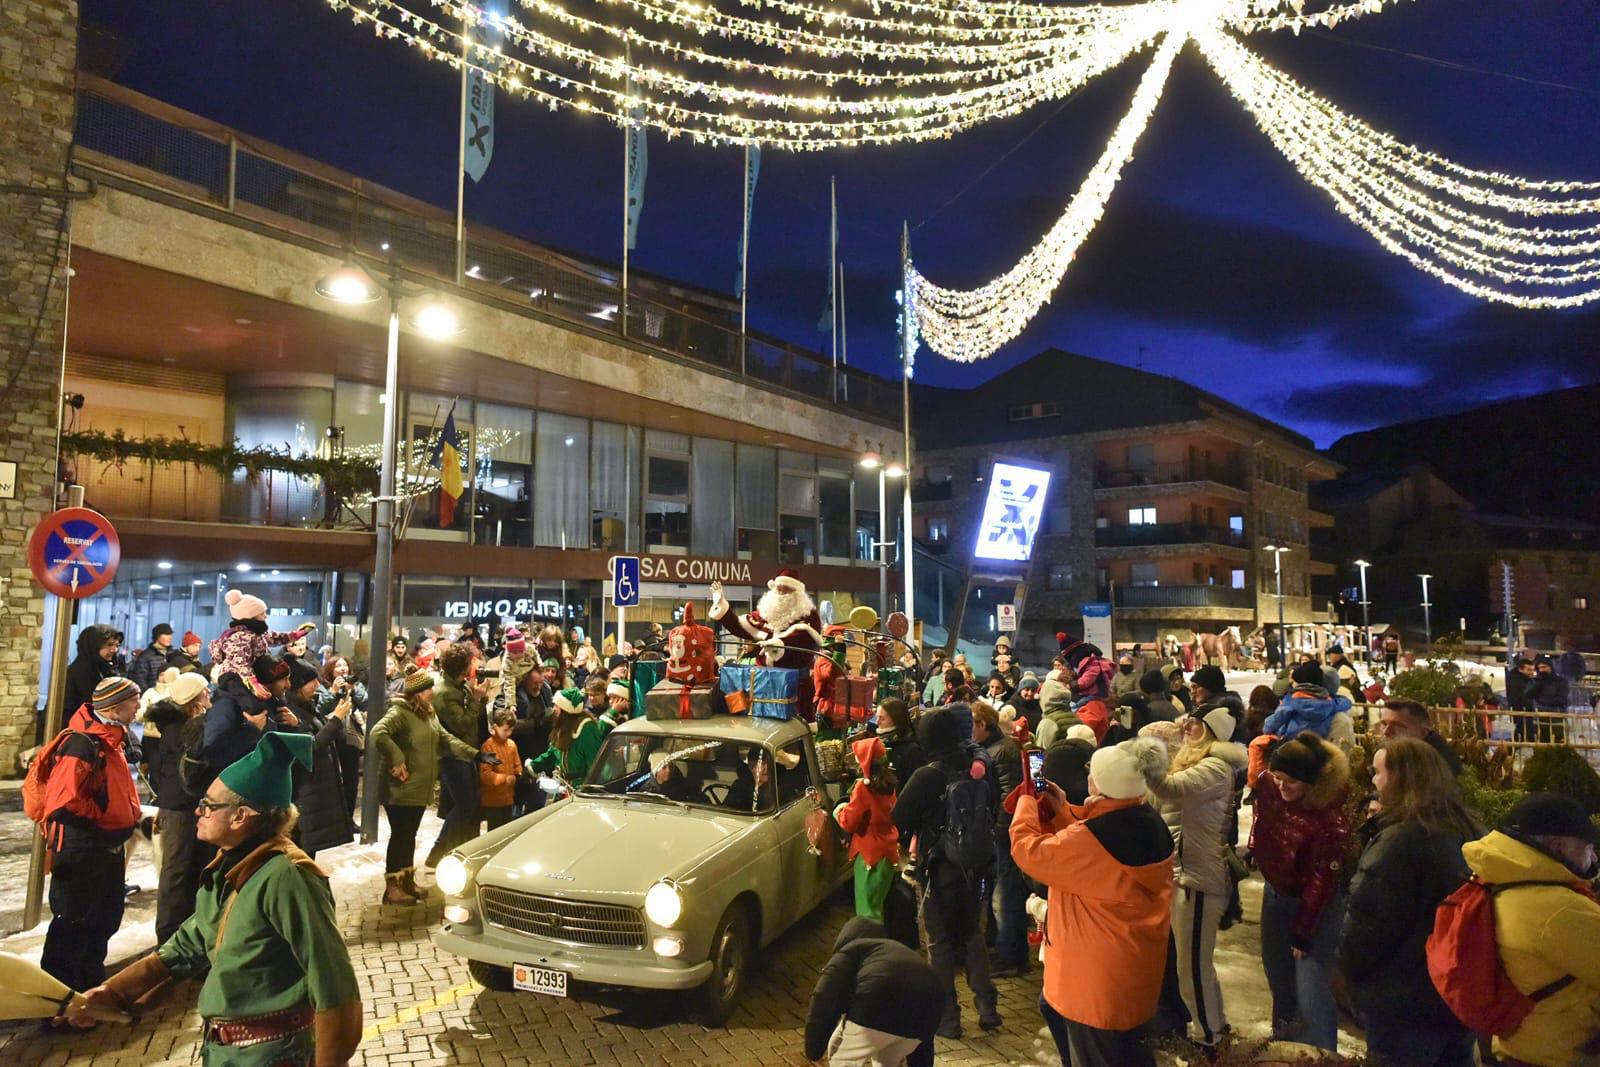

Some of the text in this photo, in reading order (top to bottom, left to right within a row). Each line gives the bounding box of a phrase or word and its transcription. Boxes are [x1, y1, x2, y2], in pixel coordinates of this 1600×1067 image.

[63, 536, 94, 546] RESERVAT
[607, 557, 752, 582] CSA COMUNA
[530, 969, 565, 989] 12993
